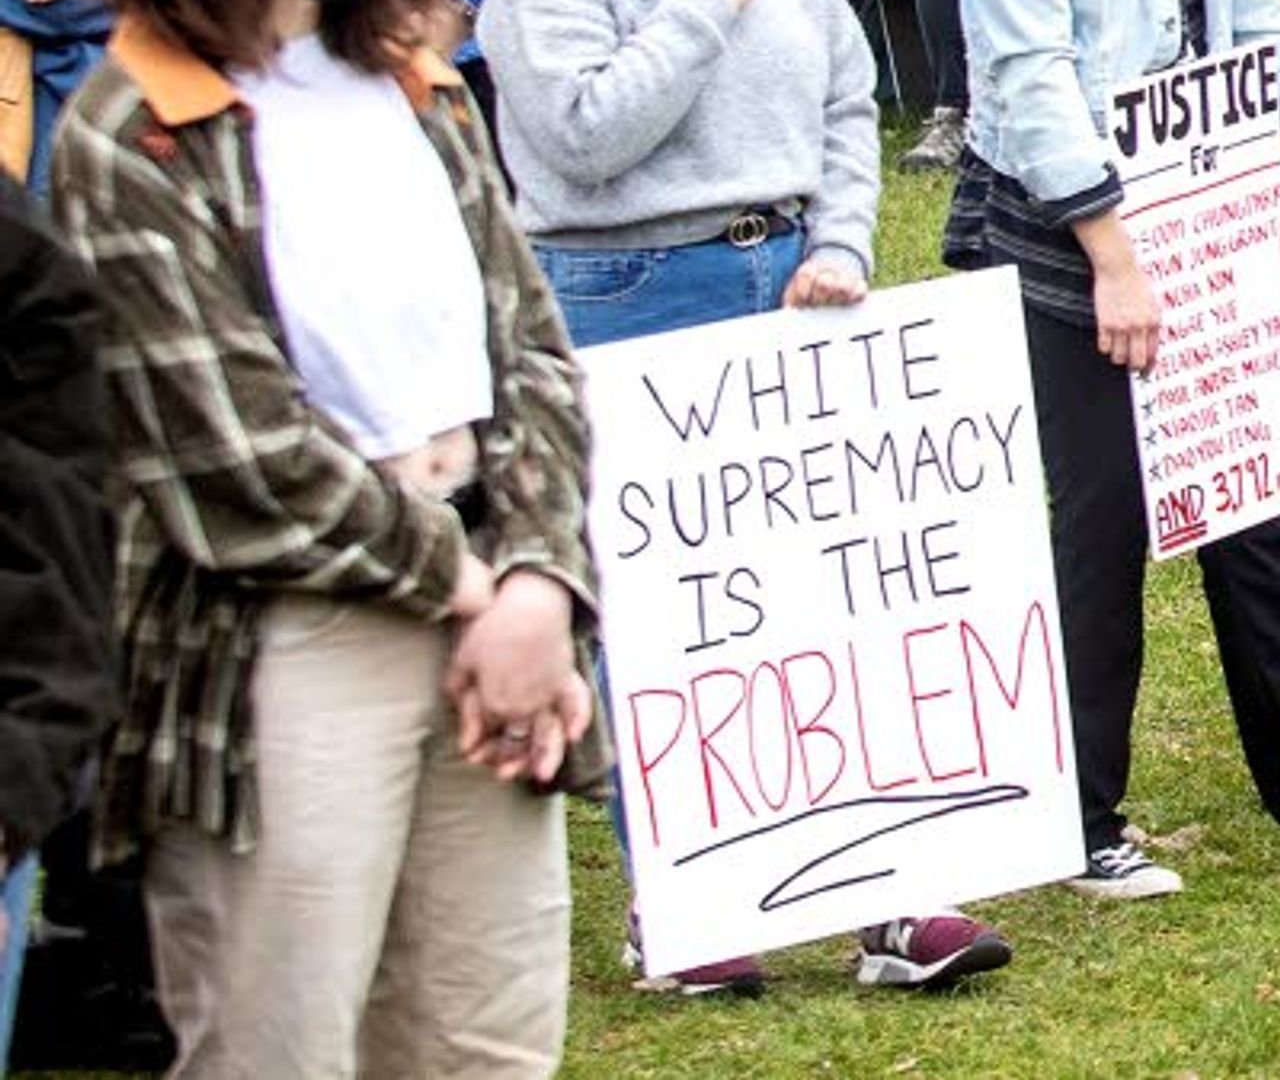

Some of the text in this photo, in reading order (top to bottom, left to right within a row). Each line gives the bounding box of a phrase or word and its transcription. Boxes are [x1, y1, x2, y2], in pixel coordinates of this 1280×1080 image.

[1113, 46, 1279, 159] JUSTICE
[643, 317, 944, 444] WHITE
[616, 404, 1023, 562] SUPREMACY
[1155, 484, 1206, 537] AND
[1212, 453, 1275, 515] 3,792
[678, 520, 972, 654] IS THE
[627, 600, 1065, 848] PROBLEM
